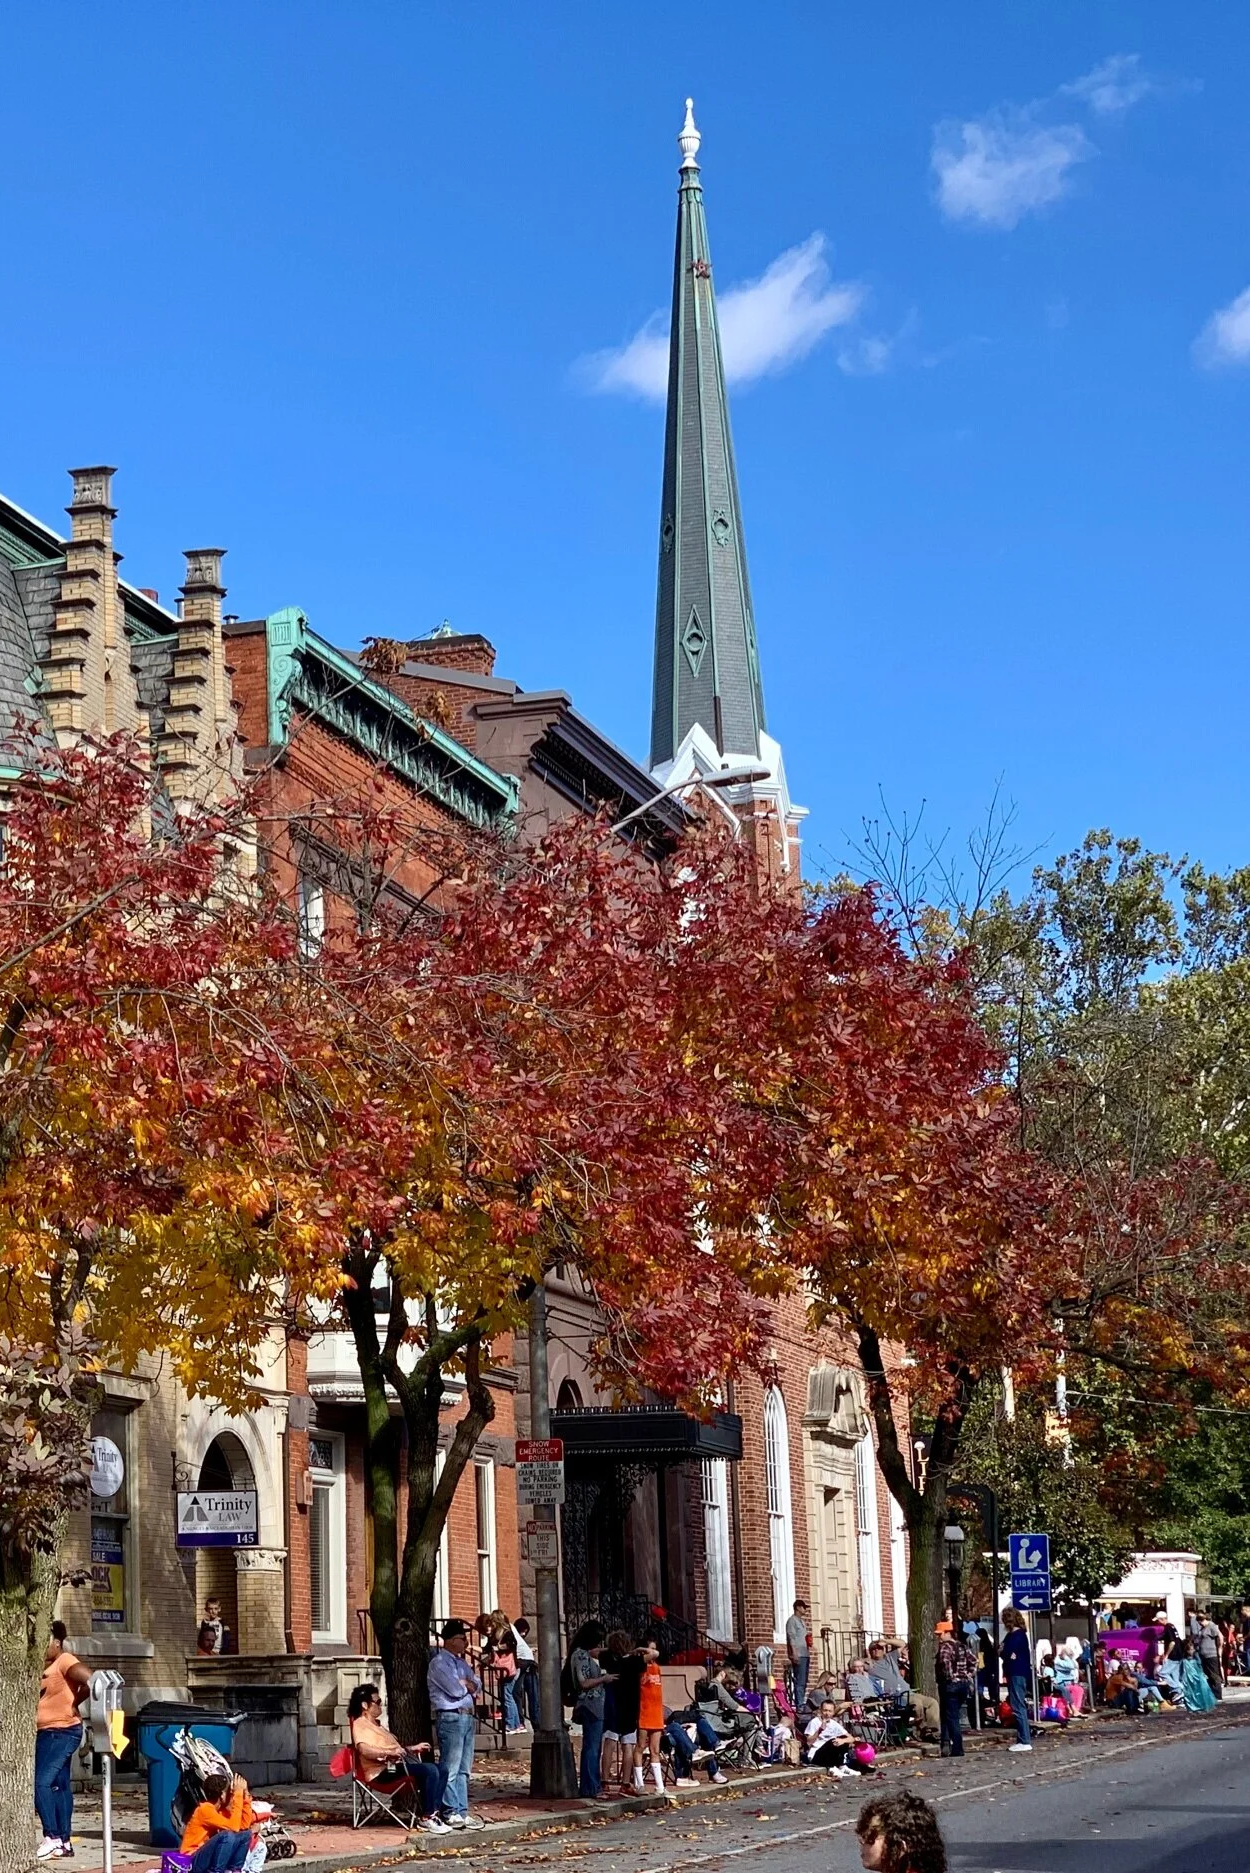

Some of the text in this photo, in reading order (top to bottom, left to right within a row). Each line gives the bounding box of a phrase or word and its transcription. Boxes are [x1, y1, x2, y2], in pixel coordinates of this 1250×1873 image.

[528, 1440, 550, 1448] SNOW
[519, 1447, 559, 1455] EMERGENCY
[97, 1447, 118, 1467] Trinity
[534, 1475, 558, 1483] PARKING
[205, 1496, 252, 1514] Trinity
[219, 1512, 241, 1522] LAW
[237, 1534, 254, 1543] 145
[92, 1553, 106, 1562] SALE
[1014, 1578, 1046, 1588] LIBRARY
